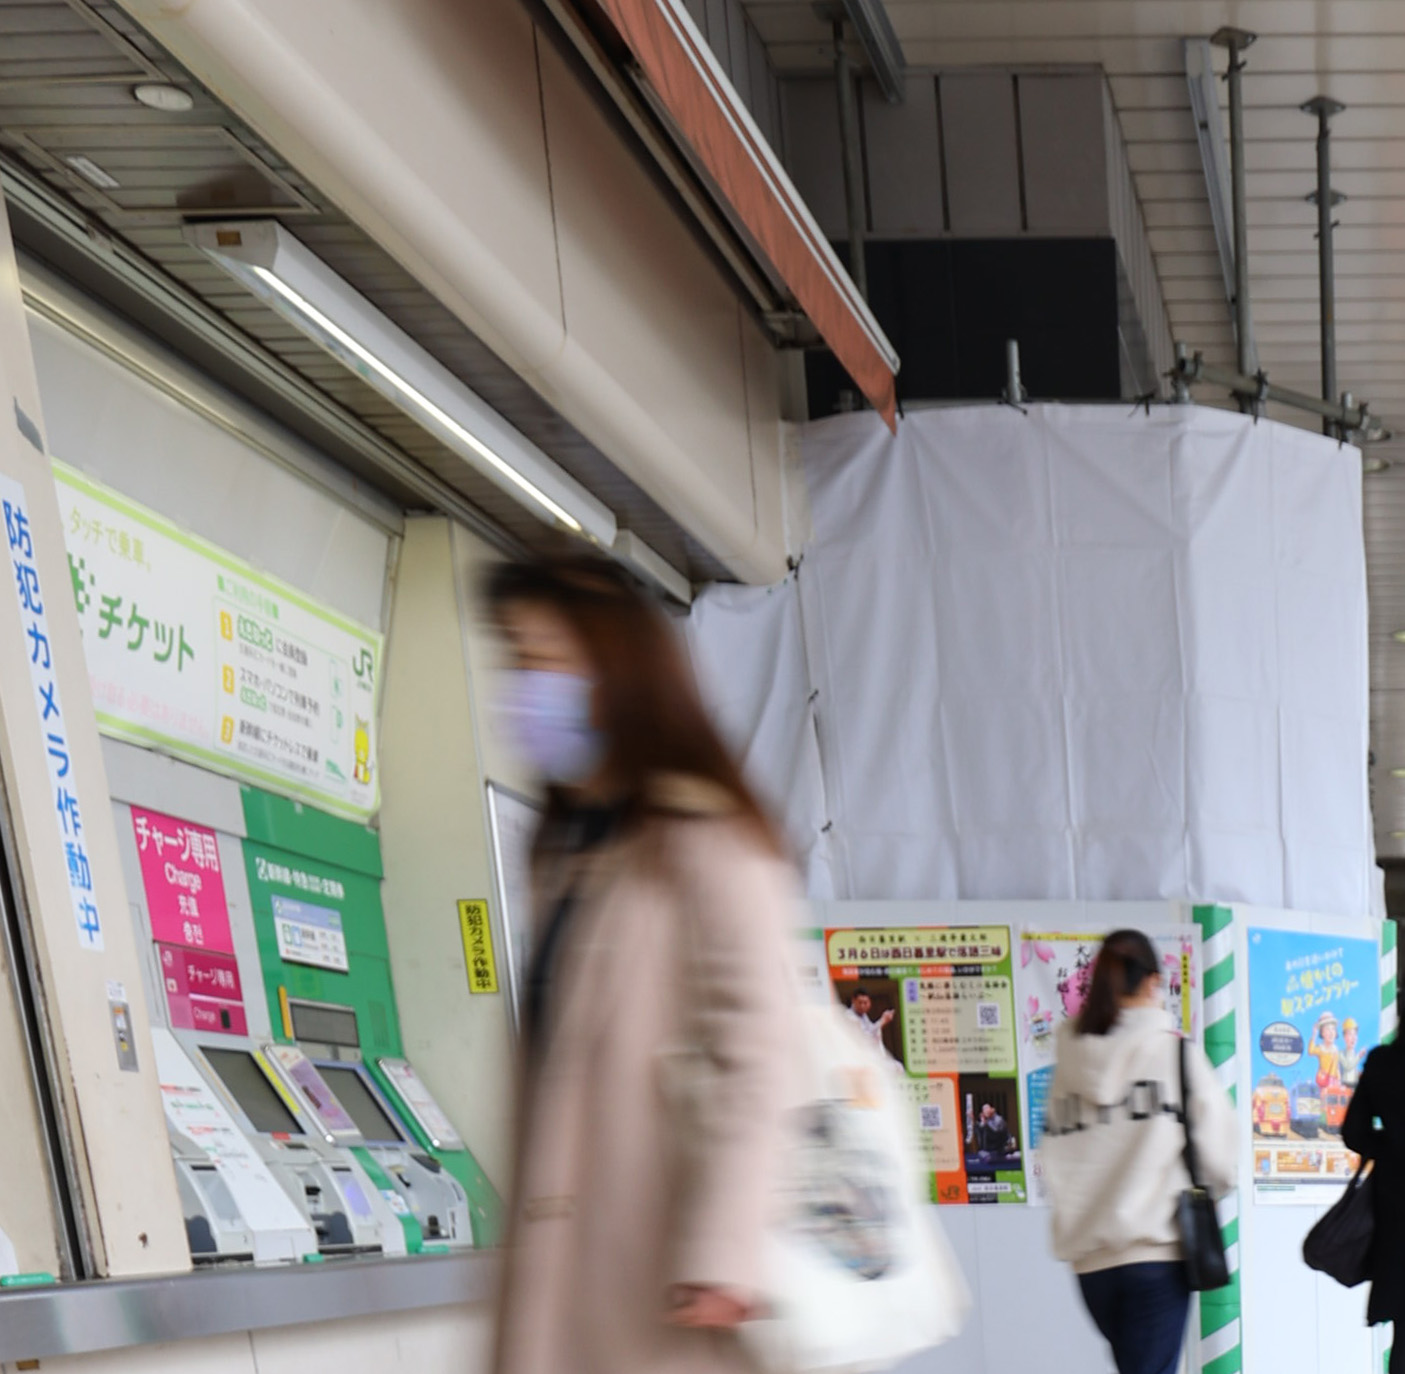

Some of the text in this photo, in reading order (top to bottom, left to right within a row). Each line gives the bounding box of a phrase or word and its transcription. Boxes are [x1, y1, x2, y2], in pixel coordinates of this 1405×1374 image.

[3, 499, 101, 944] 防犯カメラ作動中
[135, 817, 219, 873] チャージ専用
[164, 862, 202, 894] Charge
